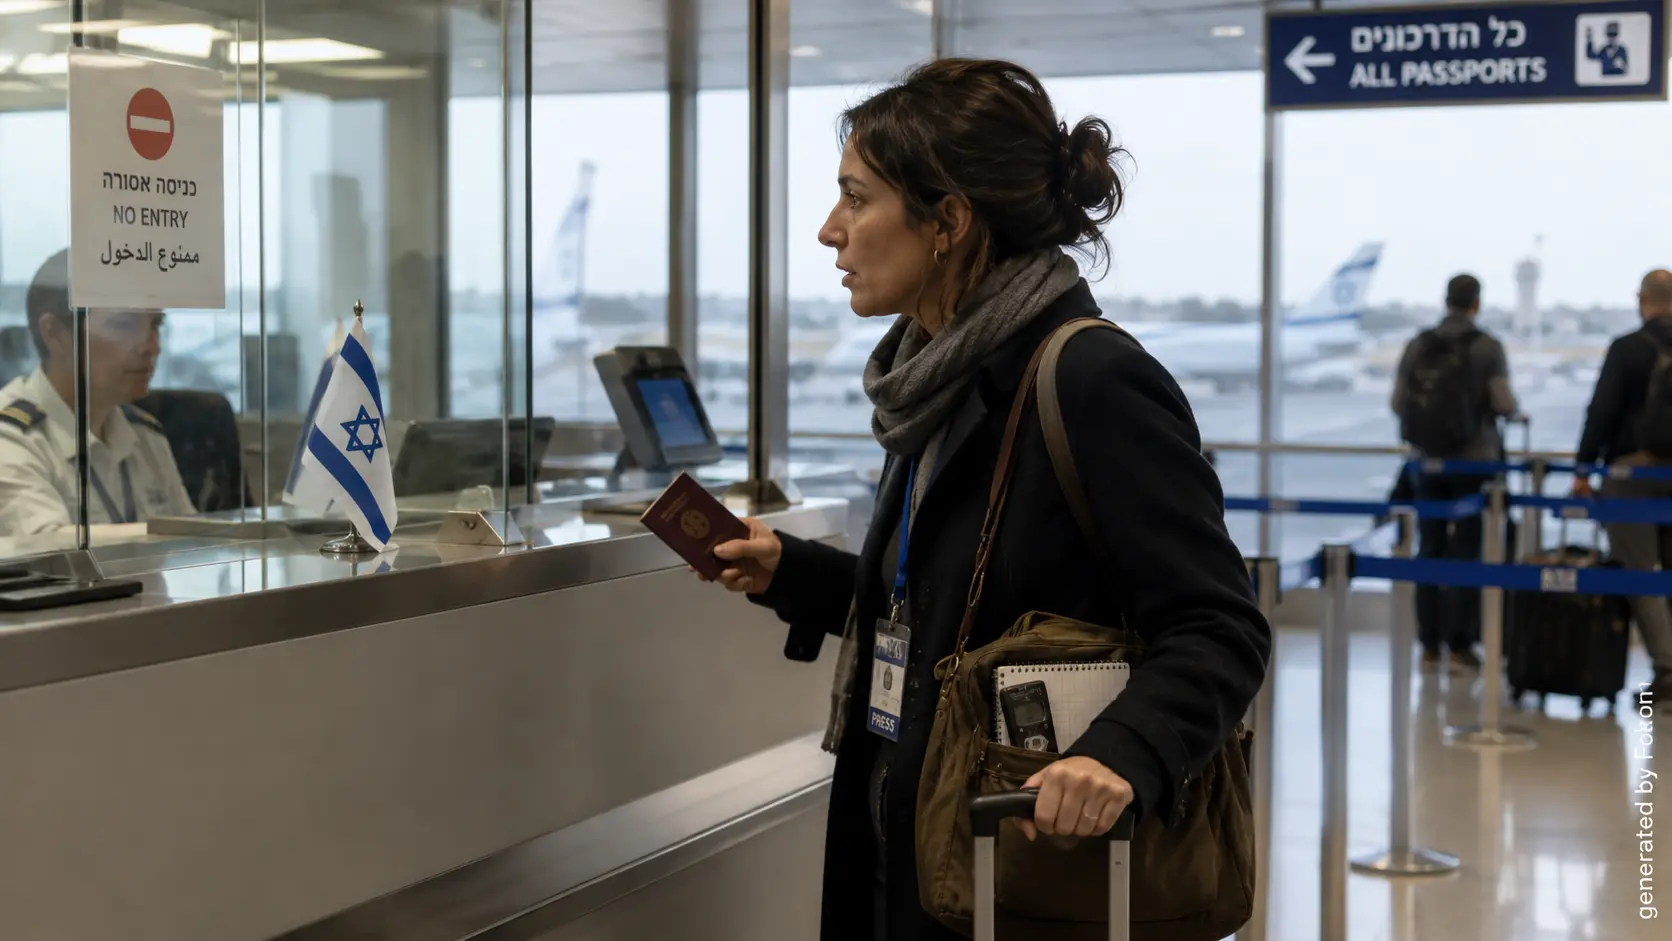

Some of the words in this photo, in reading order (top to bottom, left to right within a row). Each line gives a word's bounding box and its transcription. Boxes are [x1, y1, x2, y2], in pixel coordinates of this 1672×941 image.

[1350, 22, 1481, 53] הדרכונים
[1488, 15, 1527, 48] כל
[1349, 61, 1398, 89] ALL
[1401, 56, 1548, 88] PASSPORTS
[103, 171, 151, 193] אסורה
[156, 177, 197, 197] כניסה
[113, 204, 136, 225] NO
[141, 207, 188, 229] ENTRY
[100, 239, 153, 266] الدخول
[158, 244, 200, 272] ممنوع
[871, 711, 895, 733] PRESS
